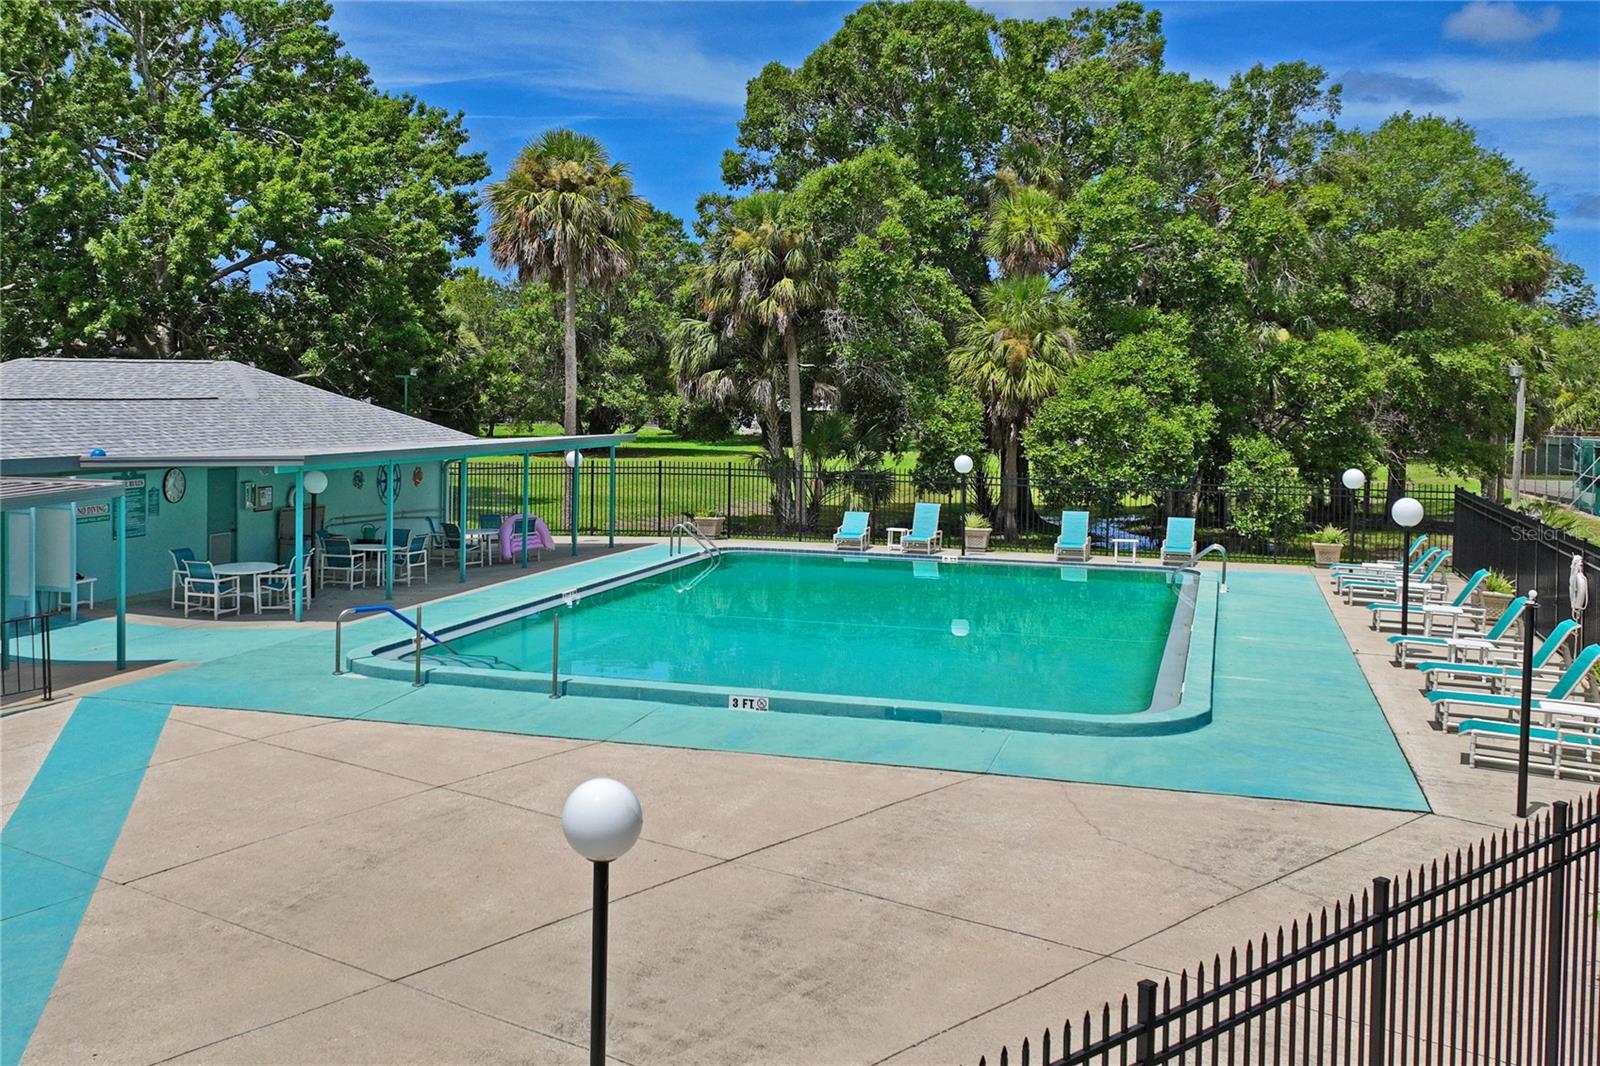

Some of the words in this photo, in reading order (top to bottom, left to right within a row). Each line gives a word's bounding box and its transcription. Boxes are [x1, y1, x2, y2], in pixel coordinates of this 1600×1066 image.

[77, 506, 87, 515] NO
[87, 504, 107, 514] DIVING
[732, 698, 739, 708] 3
